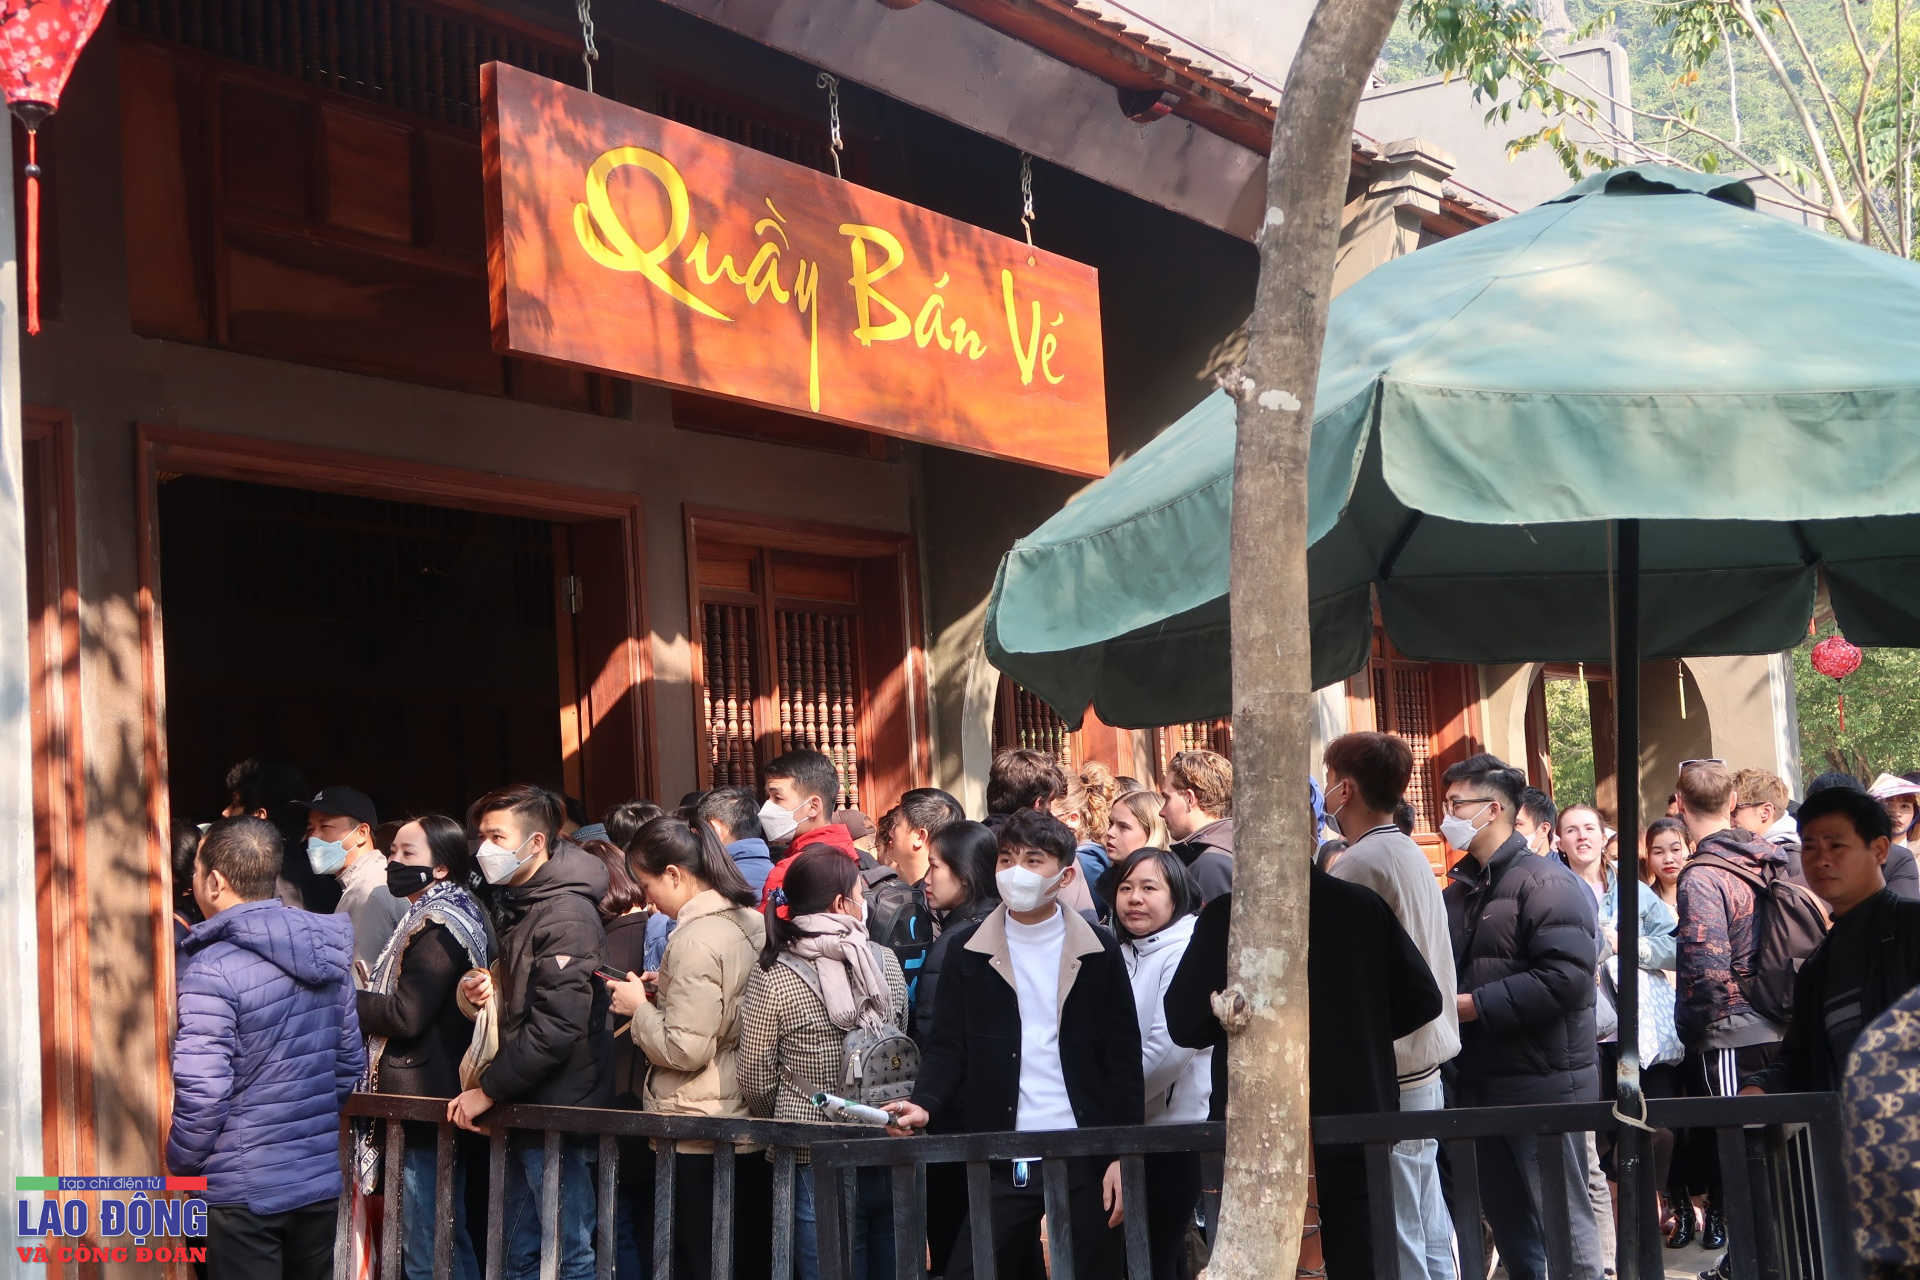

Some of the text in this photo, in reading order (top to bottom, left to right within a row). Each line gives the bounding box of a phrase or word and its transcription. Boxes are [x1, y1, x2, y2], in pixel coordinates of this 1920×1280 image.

[573, 145, 1065, 413] Quầy Bán Vé
